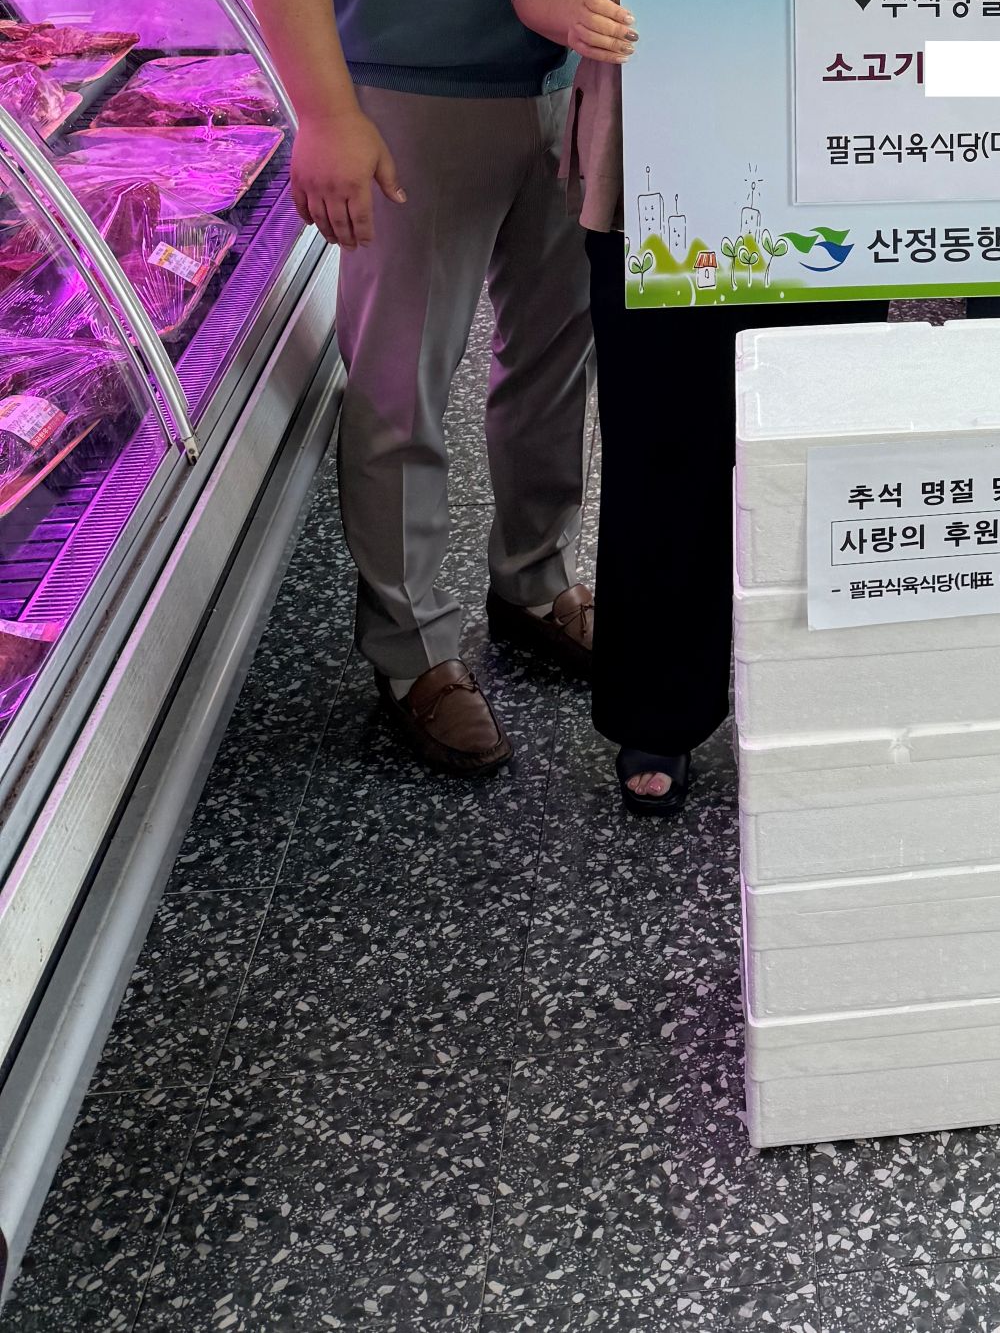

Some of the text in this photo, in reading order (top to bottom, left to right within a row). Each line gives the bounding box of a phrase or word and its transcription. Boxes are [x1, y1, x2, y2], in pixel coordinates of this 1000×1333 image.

[821, 50, 925, 87] 소고기
[847, 481, 903, 510] 추석
[920, 477, 974, 506] 명절
[839, 523, 926, 555] 사랑의
[849, 570, 994, 600] 팔금식육식당(대표
